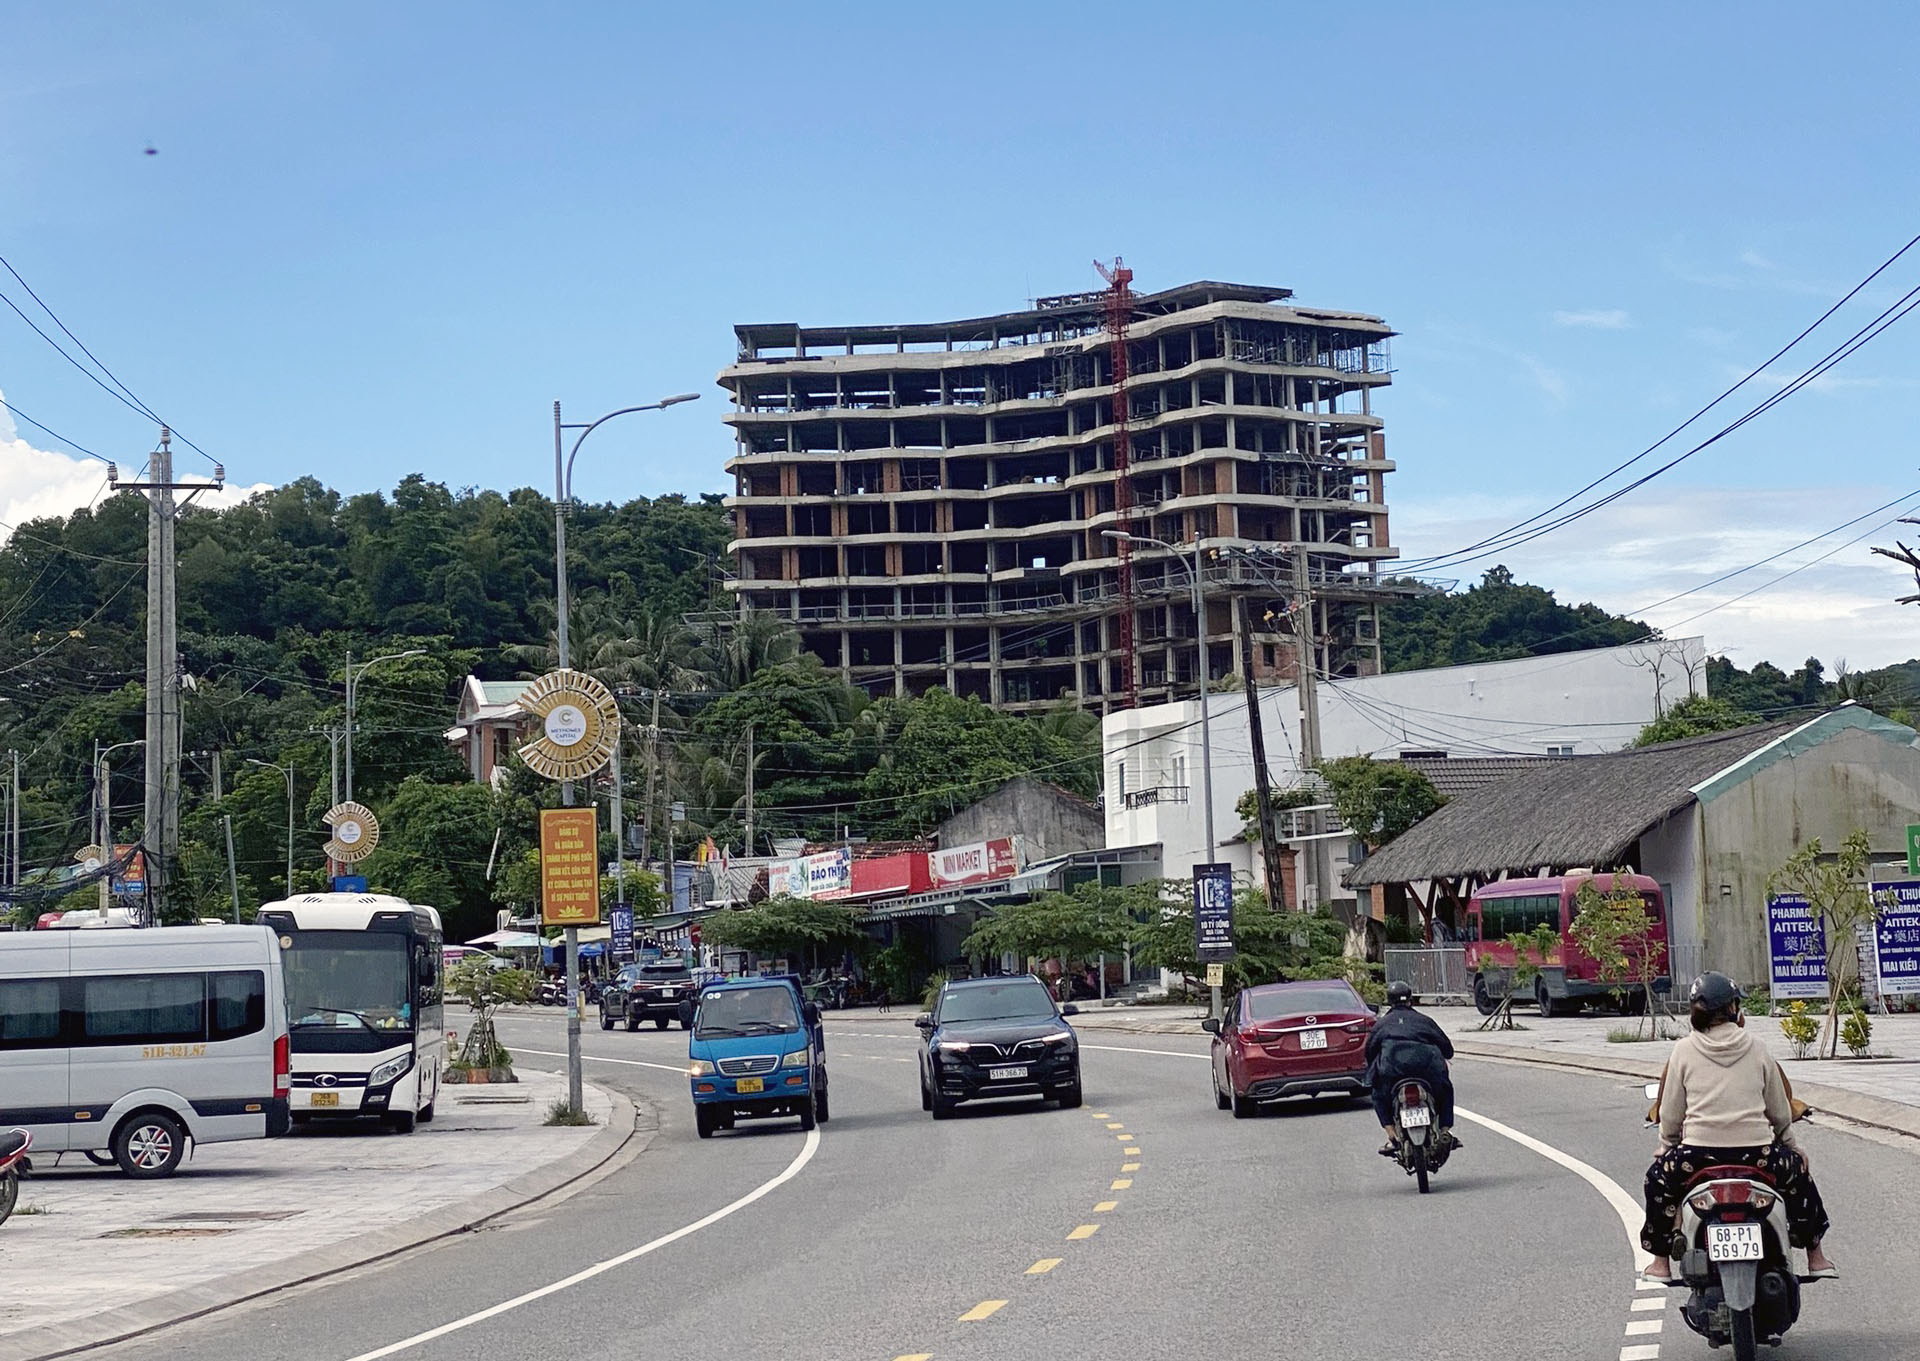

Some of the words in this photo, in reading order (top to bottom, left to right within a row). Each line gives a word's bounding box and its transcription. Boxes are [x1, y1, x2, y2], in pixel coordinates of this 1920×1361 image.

[943, 854, 956, 874] MINI
[956, 850, 981, 872] MARKET
[1771, 908, 1822, 919] PHARMA
[1774, 965, 1790, 977] MAI
[1809, 965, 1820, 976] AN
[1821, 965, 1827, 976] 2
[1882, 961, 1898, 972] MAI
[1716, 1227, 1752, 1242] 68-P1
[1712, 1242, 1760, 1258] 569.79
